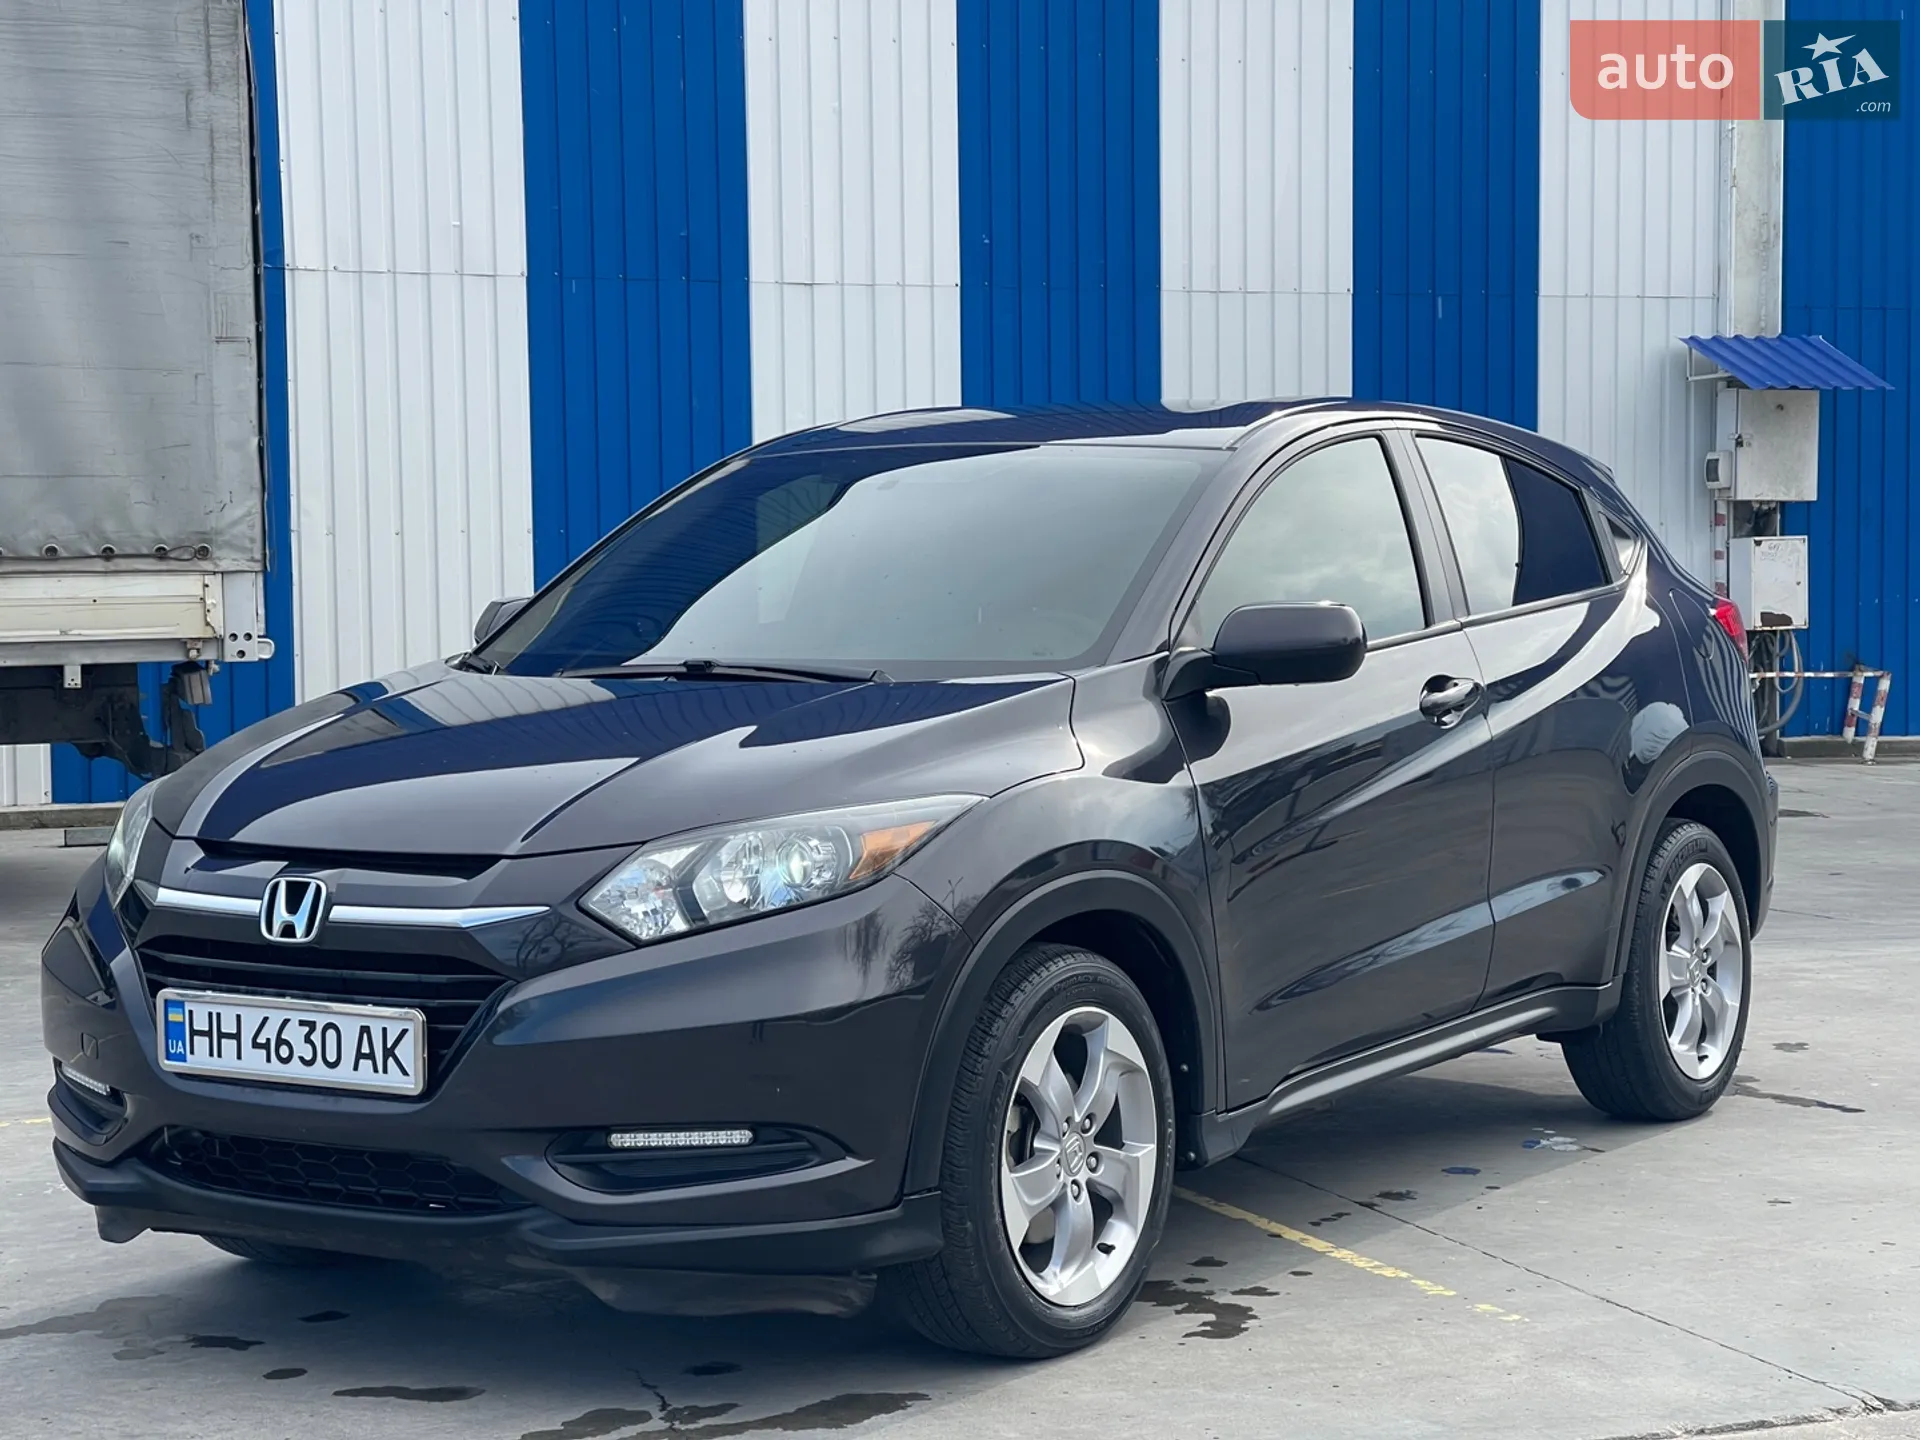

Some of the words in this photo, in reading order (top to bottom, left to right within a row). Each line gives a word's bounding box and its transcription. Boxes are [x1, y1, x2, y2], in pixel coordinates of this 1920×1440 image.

[168, 1039, 185, 1055] UA
[188, 1009, 242, 1060] HH
[251, 1016, 342, 1069] 4630
[352, 1025, 411, 1077] AK
